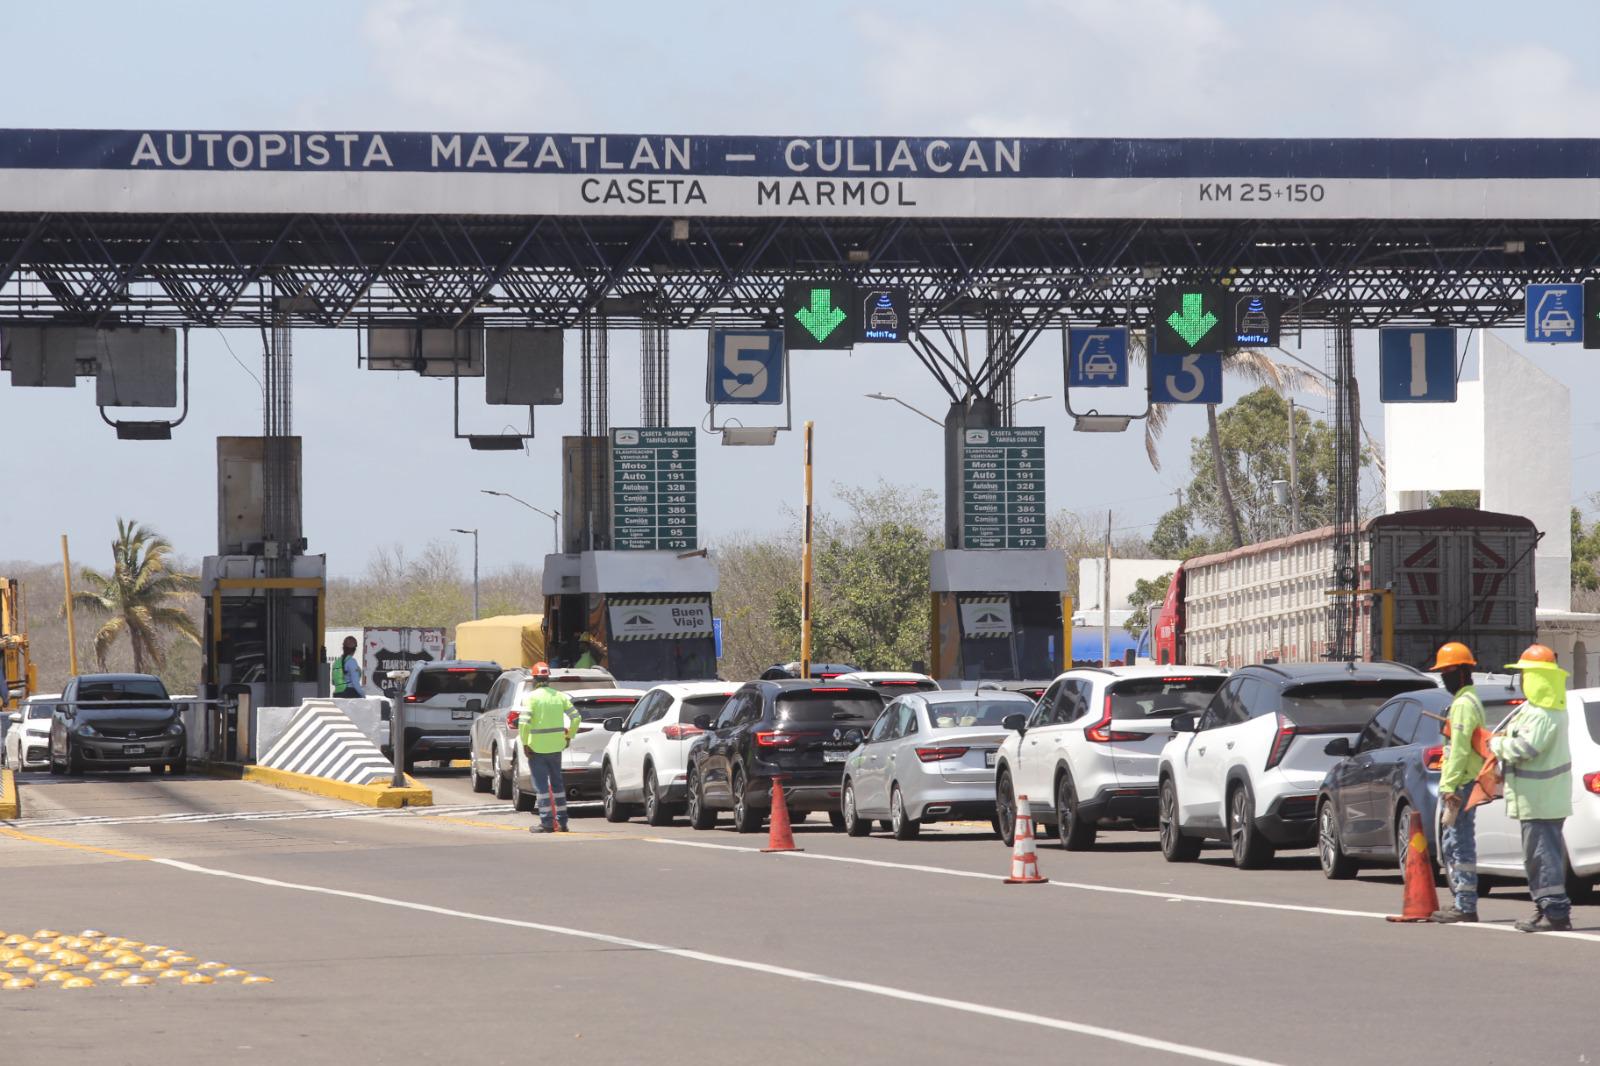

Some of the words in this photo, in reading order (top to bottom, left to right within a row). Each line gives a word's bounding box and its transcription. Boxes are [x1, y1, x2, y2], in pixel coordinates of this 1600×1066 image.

[131, 133, 393, 168] AUTOPISTA
[431, 134, 691, 170] MAZATLAN
[784, 138, 1020, 173] CULIACAN
[581, 178, 707, 204] CASETA
[758, 181, 916, 206] MARMOL
[1200, 183, 1232, 201] KM
[866, 331, 897, 339] MultiTag
[1237, 335, 1268, 343] MultiTag
[723, 335, 770, 398] 5
[1410, 333, 1428, 396] 1
[1165, 354, 1205, 402] 3
[622, 472, 646, 480] Auto
[972, 471, 996, 479] Auto
[1019, 527, 1033, 535] 95
[669, 540, 686, 548] 173
[671, 608, 703, 617] Buen
[673, 617, 704, 628] Viaje
